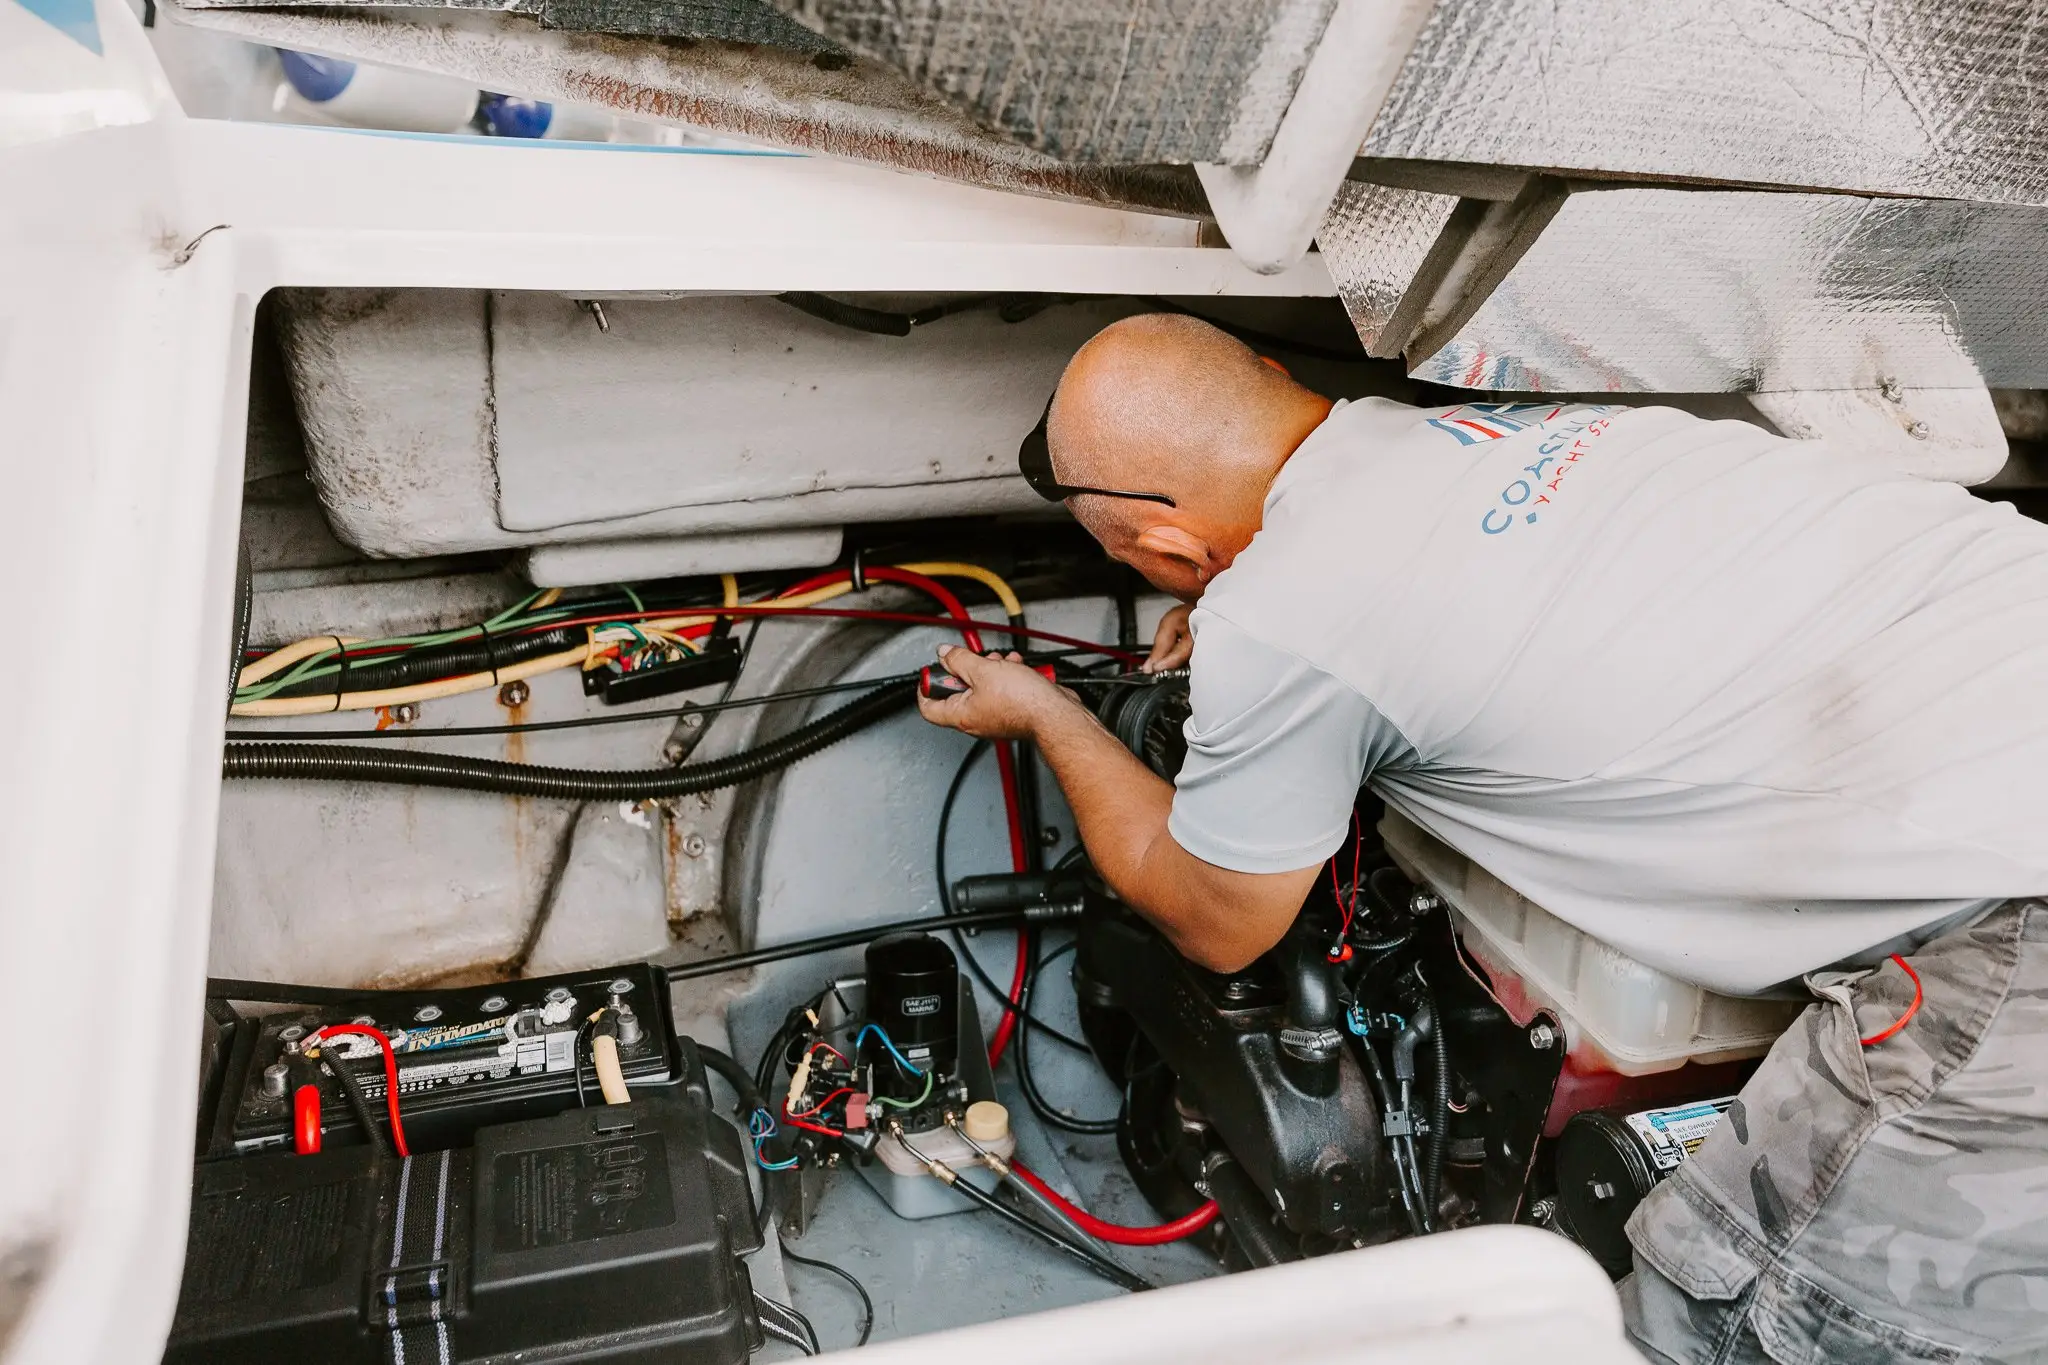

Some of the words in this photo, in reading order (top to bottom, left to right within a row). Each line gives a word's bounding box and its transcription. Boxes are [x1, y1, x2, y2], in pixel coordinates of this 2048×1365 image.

[1533, 440, 1590, 505] YACHT
[407, 1015, 510, 1053] INTIMIDATO
[1679, 1129, 1702, 1139] WATER
[1687, 1120, 1716, 1131] OWNERS
